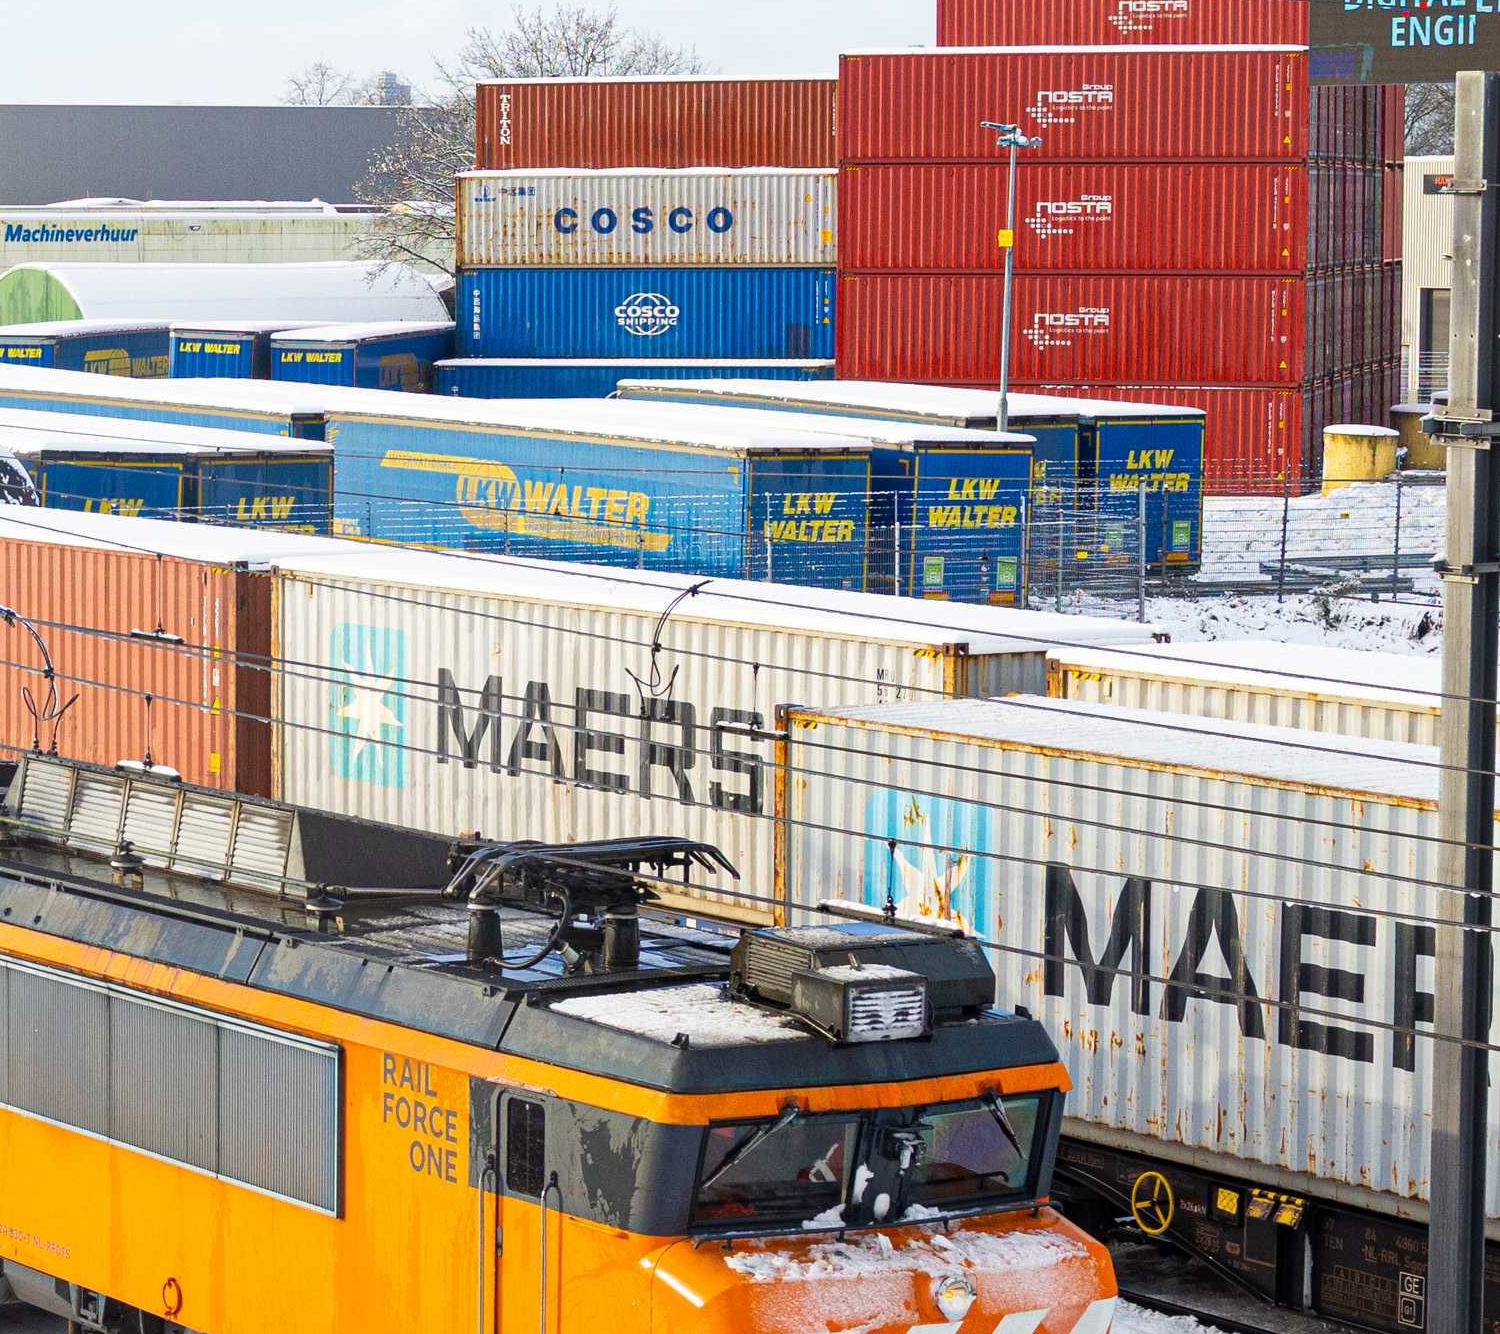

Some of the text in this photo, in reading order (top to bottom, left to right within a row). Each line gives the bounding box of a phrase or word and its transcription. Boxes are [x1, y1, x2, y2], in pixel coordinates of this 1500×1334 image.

[500, 94, 511, 146] TRITON
[554, 206, 734, 235] COSCO
[5, 223, 139, 243] Machineverhuur
[614, 304, 680, 318] COSCO
[618, 317, 677, 326] SHIPPING
[7, 348, 42, 359] WALTER
[180, 342, 240, 355] LKW WALTER
[281, 351, 342, 364] LKW WALTER
[388, 454, 458, 470] INTERNATIONALE
[1126, 449, 1175, 470] LKW
[947, 478, 1000, 501] LKW
[1110, 473, 1190, 494] WALTER
[236, 496, 295, 520] LKW
[524, 480, 649, 525] WALTER
[783, 492, 838, 515] LKW
[928, 505, 1018, 529] WALTER
[763, 519, 854, 543] WALTER
[437, 666, 764, 816] MAERS
[382, 1052, 437, 1097] RAIL
[382, 1091, 459, 1144] FORCE
[409, 1140, 459, 1184] ONE
[1324, 1233, 1344, 1251] TEN
[1364, 1243, 1401, 1267] NL-RRL
[1364, 1227, 1377, 1243] 84
[1395, 1235, 1419, 1253] 4960
[1404, 1276, 1420, 1295] GE
[1403, 1304, 1413, 1316] G1
